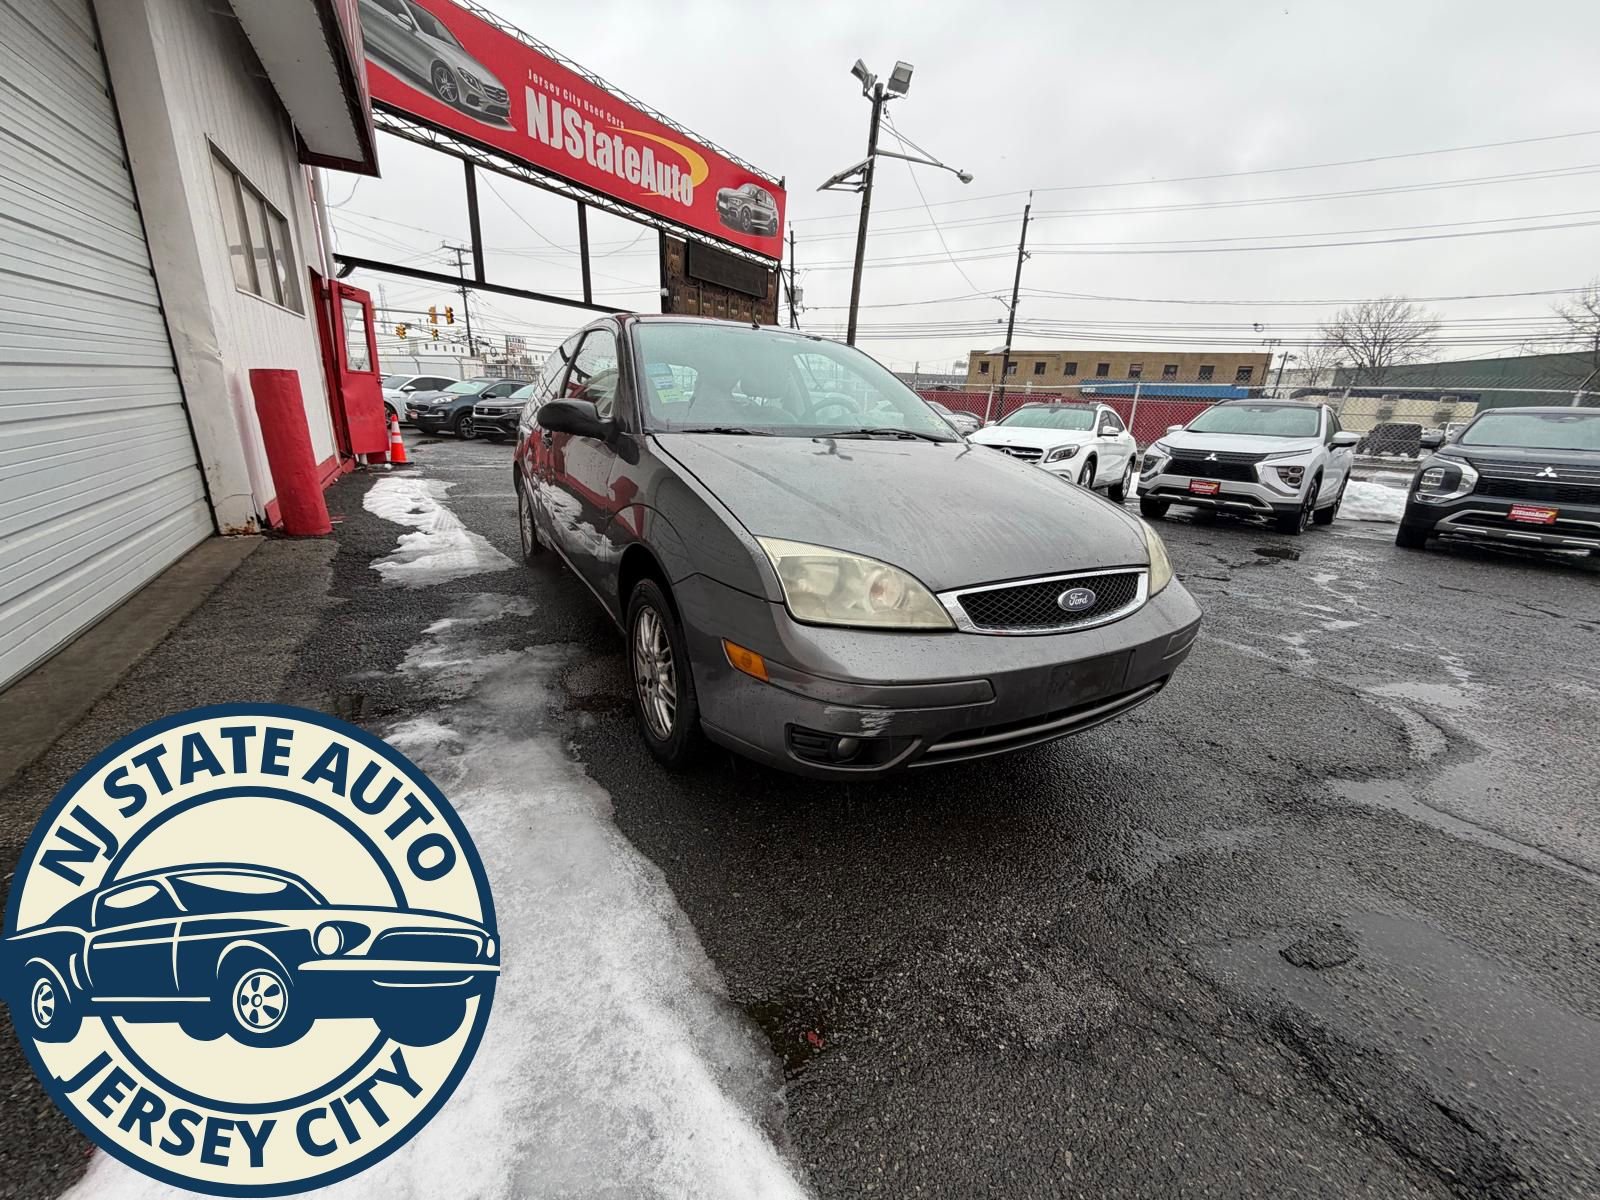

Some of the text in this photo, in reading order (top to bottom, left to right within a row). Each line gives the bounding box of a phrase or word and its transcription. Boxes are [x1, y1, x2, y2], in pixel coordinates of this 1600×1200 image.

[528, 69, 625, 129] Jersey City Used Cars
[525, 85, 693, 207] NJStateAuto
[1069, 592, 1088, 606] Ford
